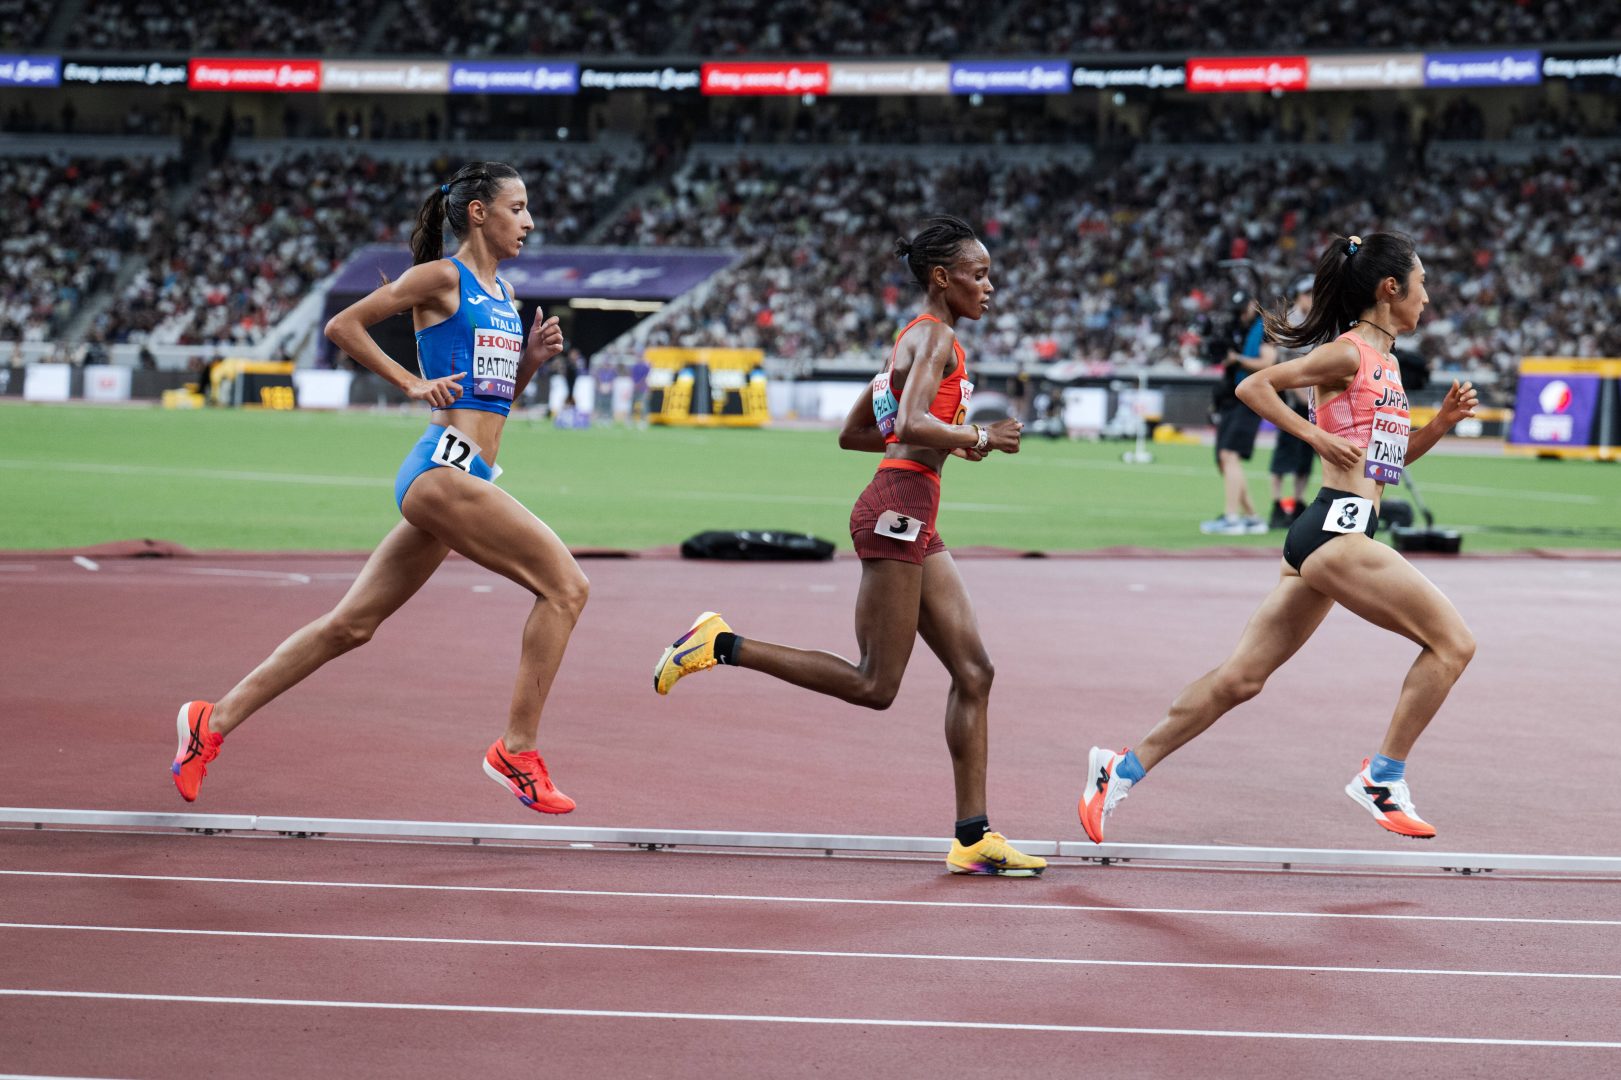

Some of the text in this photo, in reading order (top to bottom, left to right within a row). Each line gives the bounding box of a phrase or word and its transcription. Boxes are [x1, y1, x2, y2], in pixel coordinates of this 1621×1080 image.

[490, 317, 522, 334] ITALIA
[442, 433, 471, 471] 12
[889, 514, 911, 534] 3
[1336, 502, 1359, 529] 8
